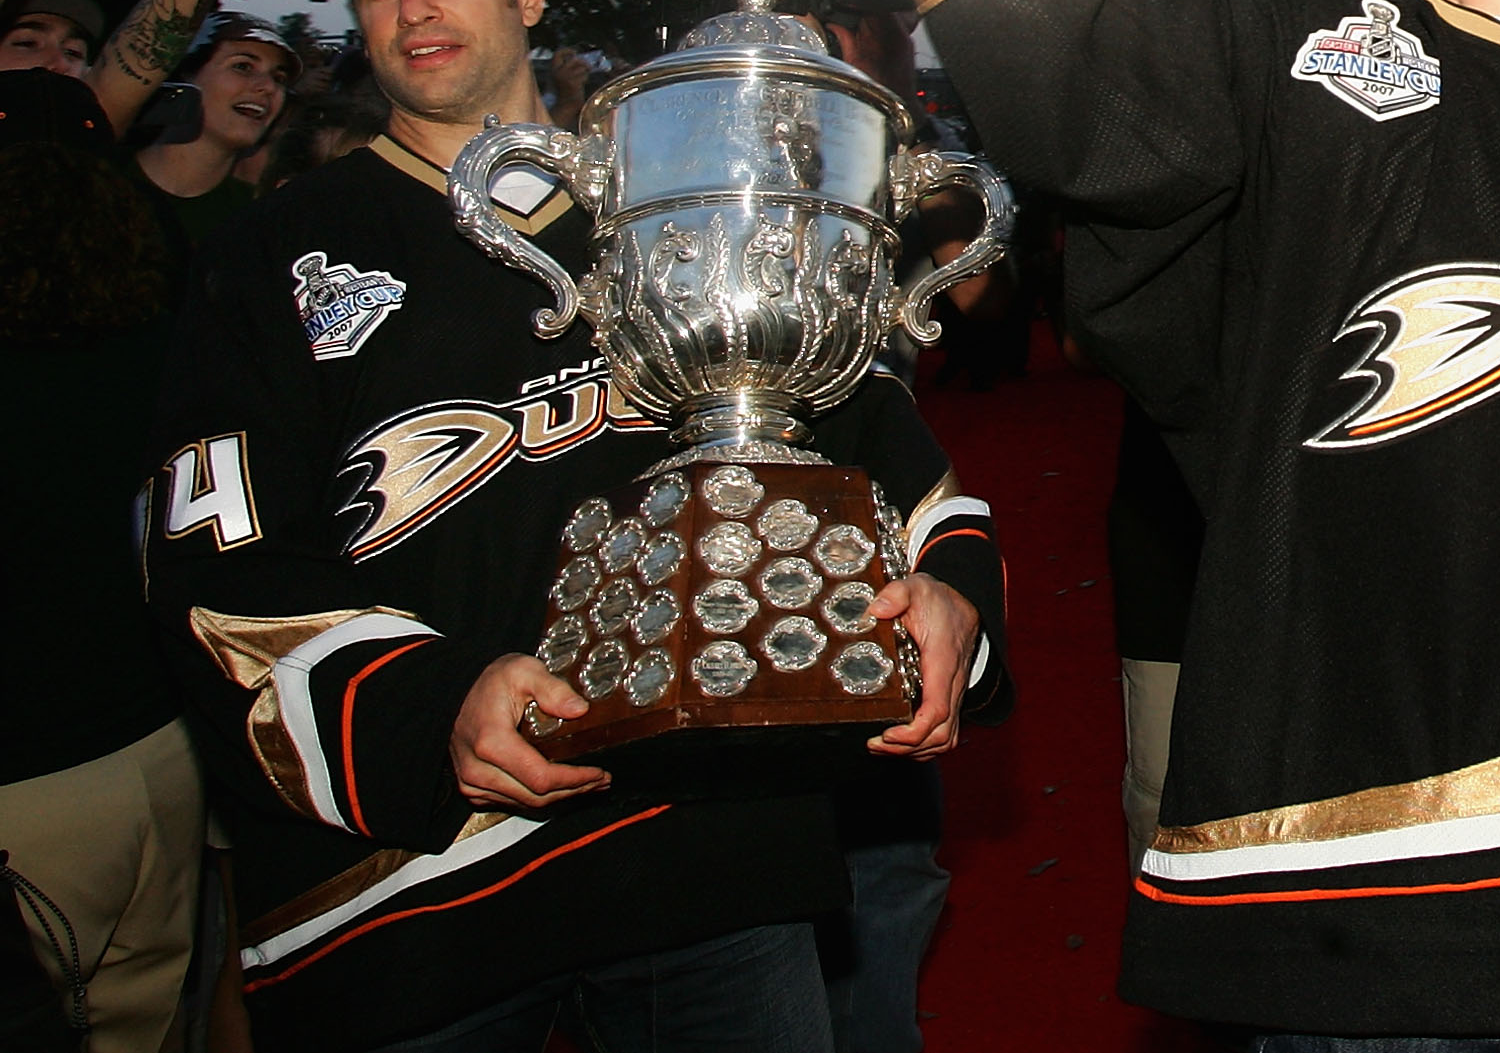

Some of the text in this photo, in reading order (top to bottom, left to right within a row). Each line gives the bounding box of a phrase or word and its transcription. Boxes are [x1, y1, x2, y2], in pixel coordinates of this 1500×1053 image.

[1303, 51, 1407, 87] STANLEY
[1407, 70, 1440, 96] CU
[1361, 82, 1394, 96] 2007
[356, 285, 403, 309] CUP
[327, 319, 353, 341] 2007
[140, 431, 263, 552] 4
